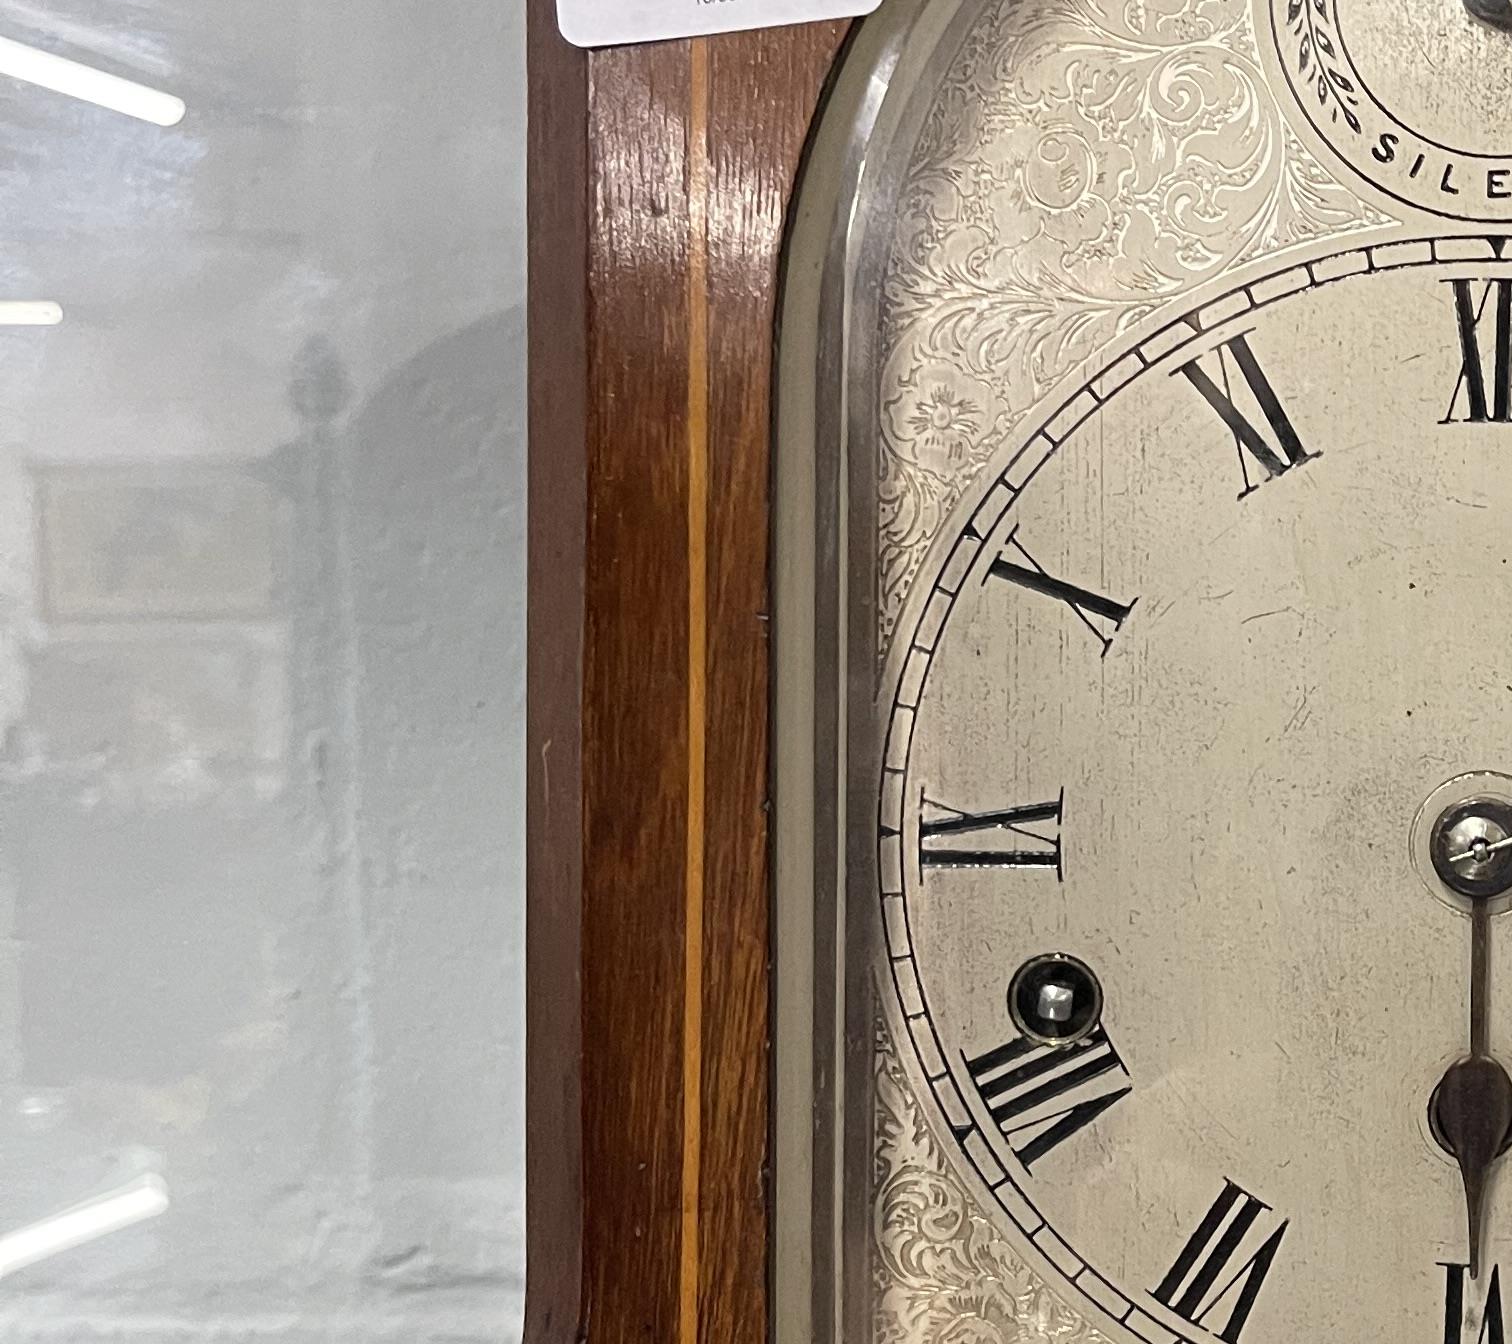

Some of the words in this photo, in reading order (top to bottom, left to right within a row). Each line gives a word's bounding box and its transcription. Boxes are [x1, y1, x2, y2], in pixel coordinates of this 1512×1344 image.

[1169, 327, 1324, 502] XI
[981, 524, 1139, 658] X
[920, 786, 1064, 883] IX
